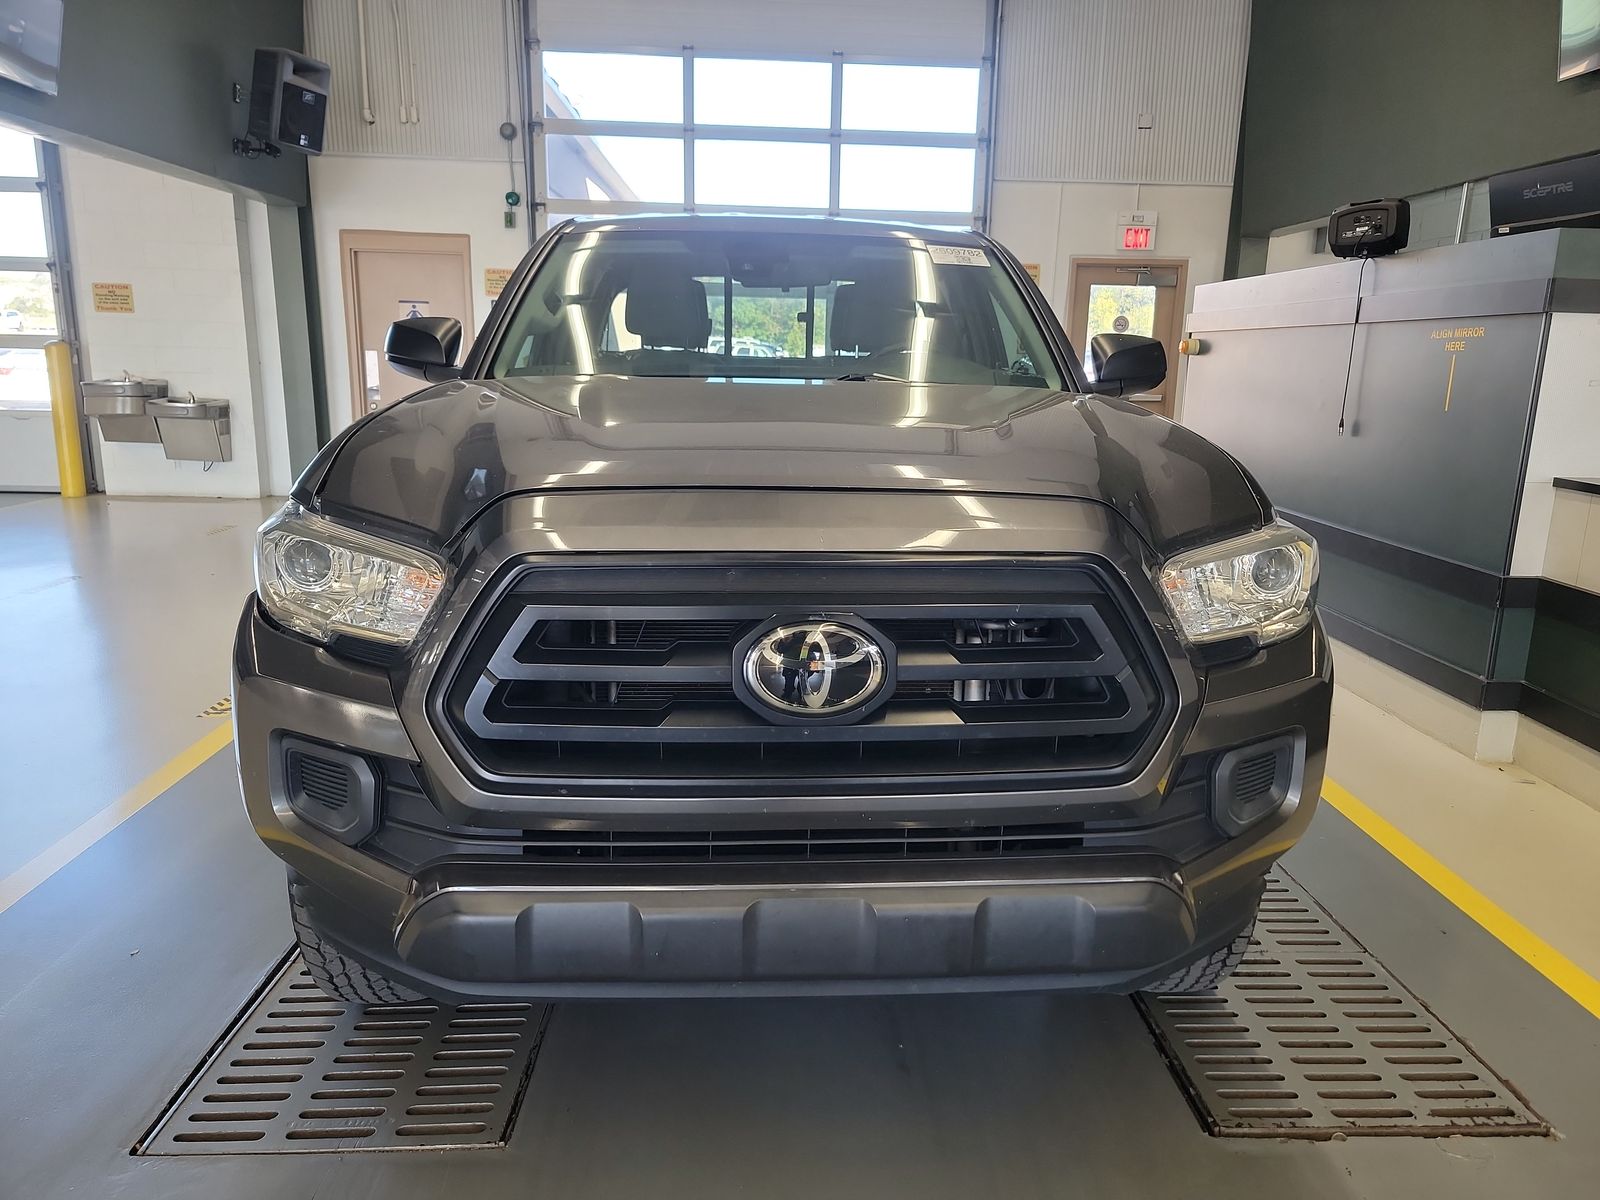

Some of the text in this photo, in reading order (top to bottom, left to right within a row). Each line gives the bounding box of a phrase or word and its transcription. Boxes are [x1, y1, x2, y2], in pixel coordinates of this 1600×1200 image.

[1523, 181, 1574, 199] SCEPTRE
[1124, 228, 1151, 248] EXIT
[1430, 326, 1486, 339] ALIGN MIRROR
[1444, 341, 1466, 351] HERE
